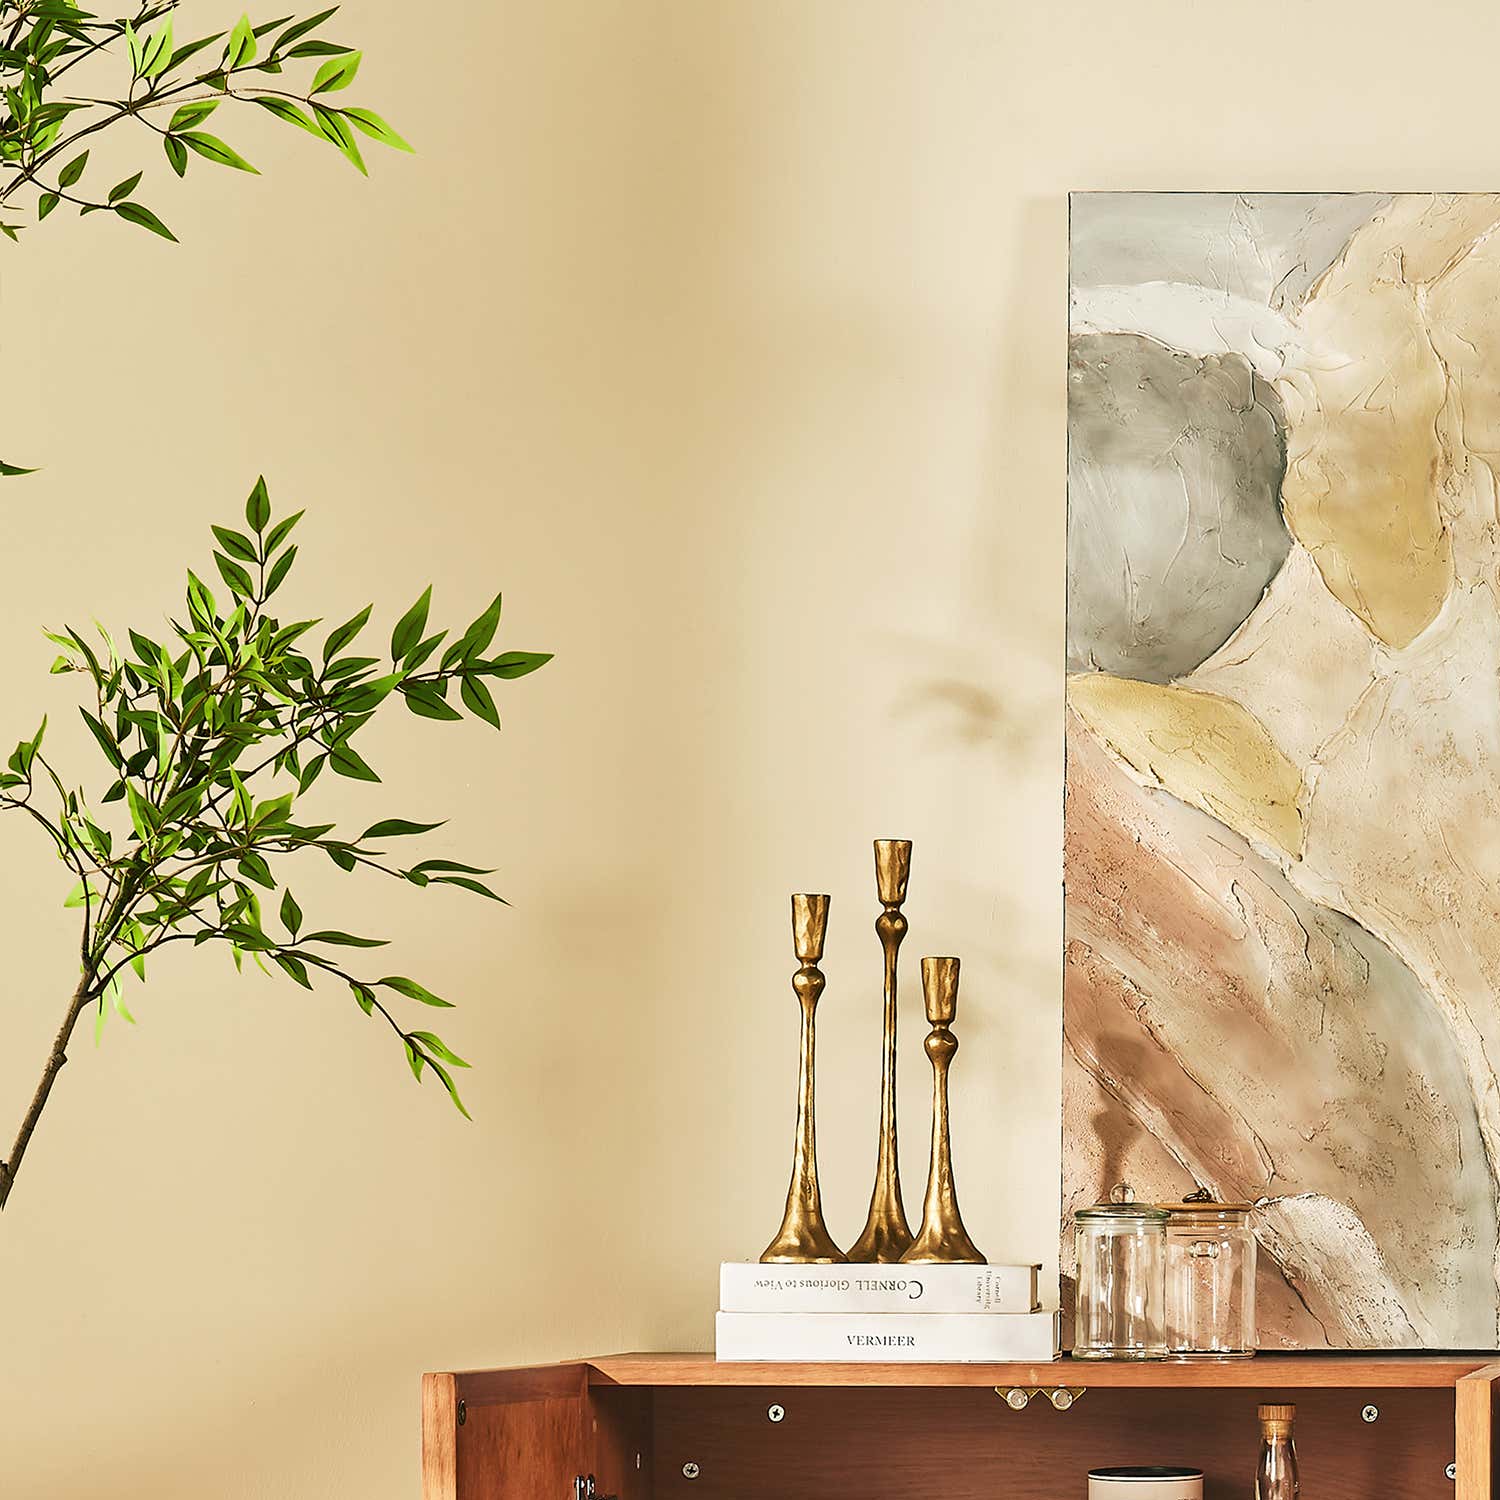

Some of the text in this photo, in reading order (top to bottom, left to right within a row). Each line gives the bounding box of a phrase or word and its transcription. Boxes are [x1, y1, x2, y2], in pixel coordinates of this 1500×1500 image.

[754, 1279, 924, 1300] CORNELL Glorious to View
[847, 1335, 915, 1346] VERMEER
